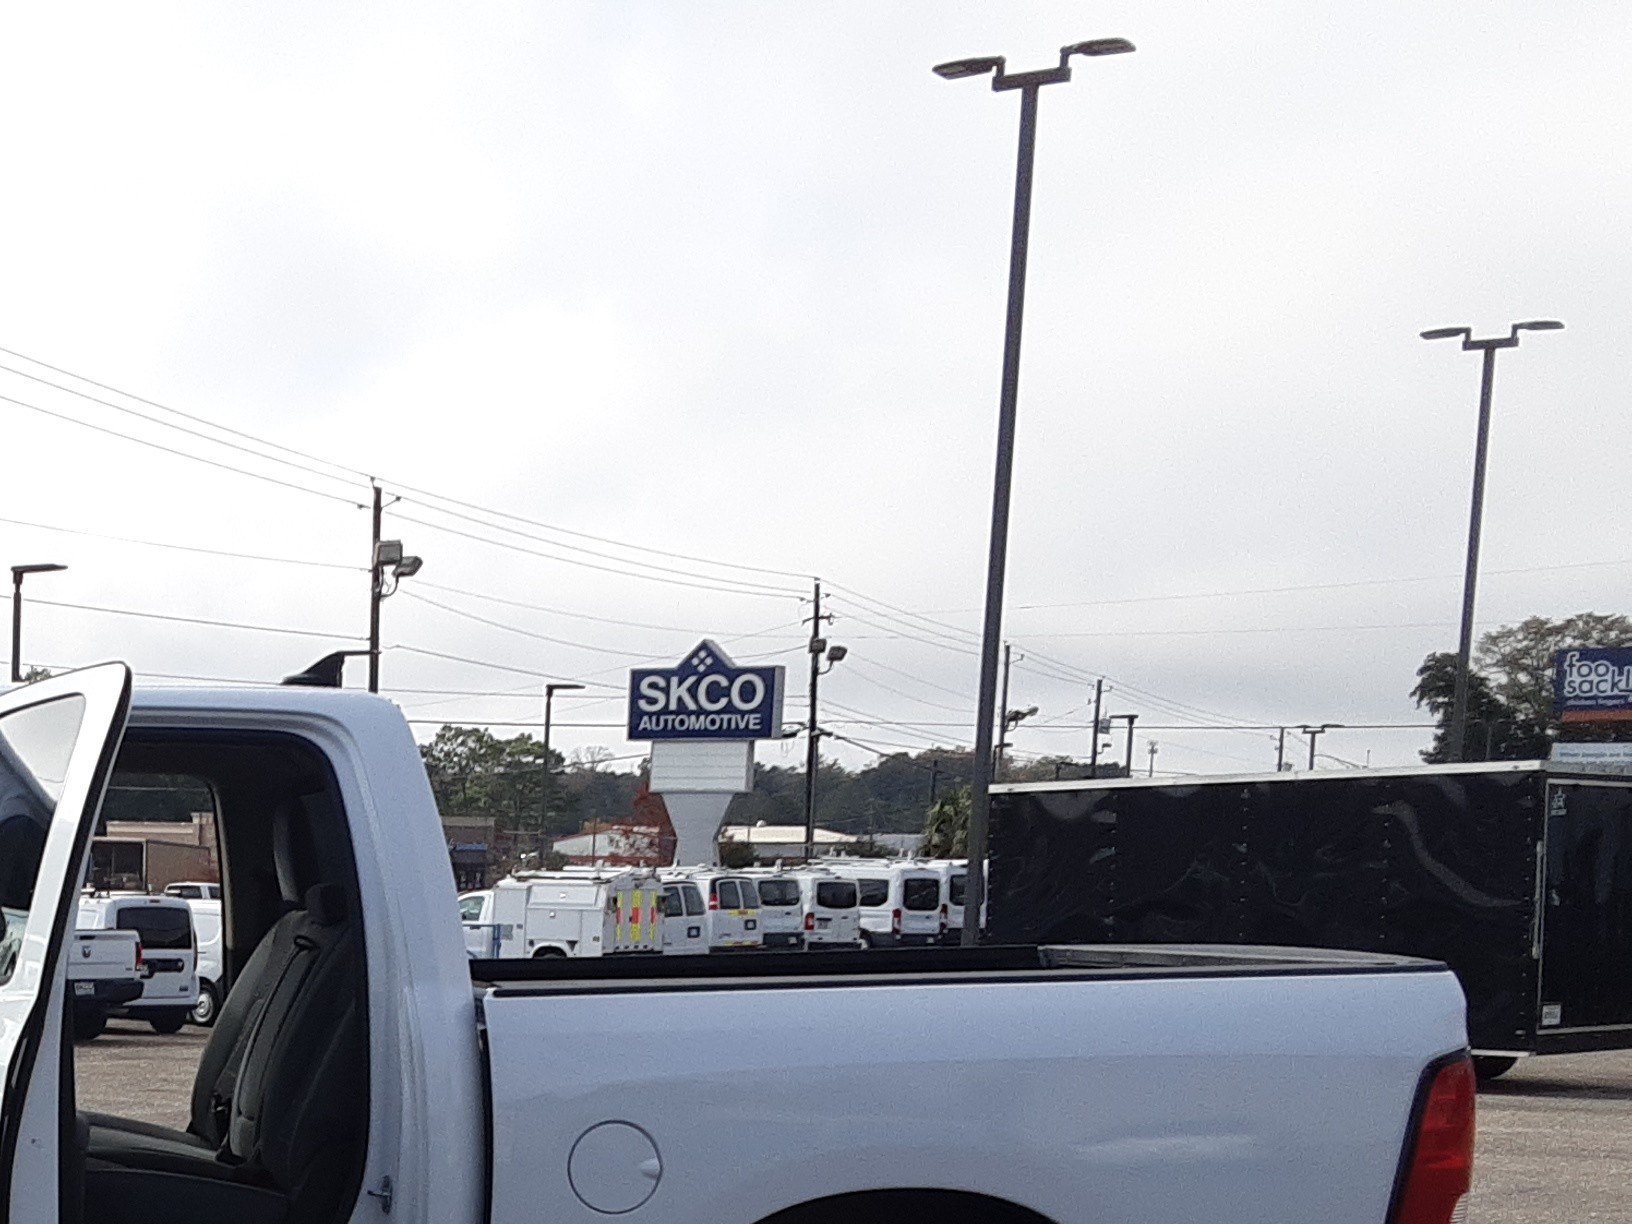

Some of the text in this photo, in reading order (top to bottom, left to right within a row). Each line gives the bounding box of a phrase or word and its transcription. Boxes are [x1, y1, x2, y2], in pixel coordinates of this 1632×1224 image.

[1565, 652, 1611, 678] foo
[637, 673, 766, 712] SKCO
[1565, 668, 1632, 693] sackl
[638, 713, 762, 731] AUTOMOTIVE
